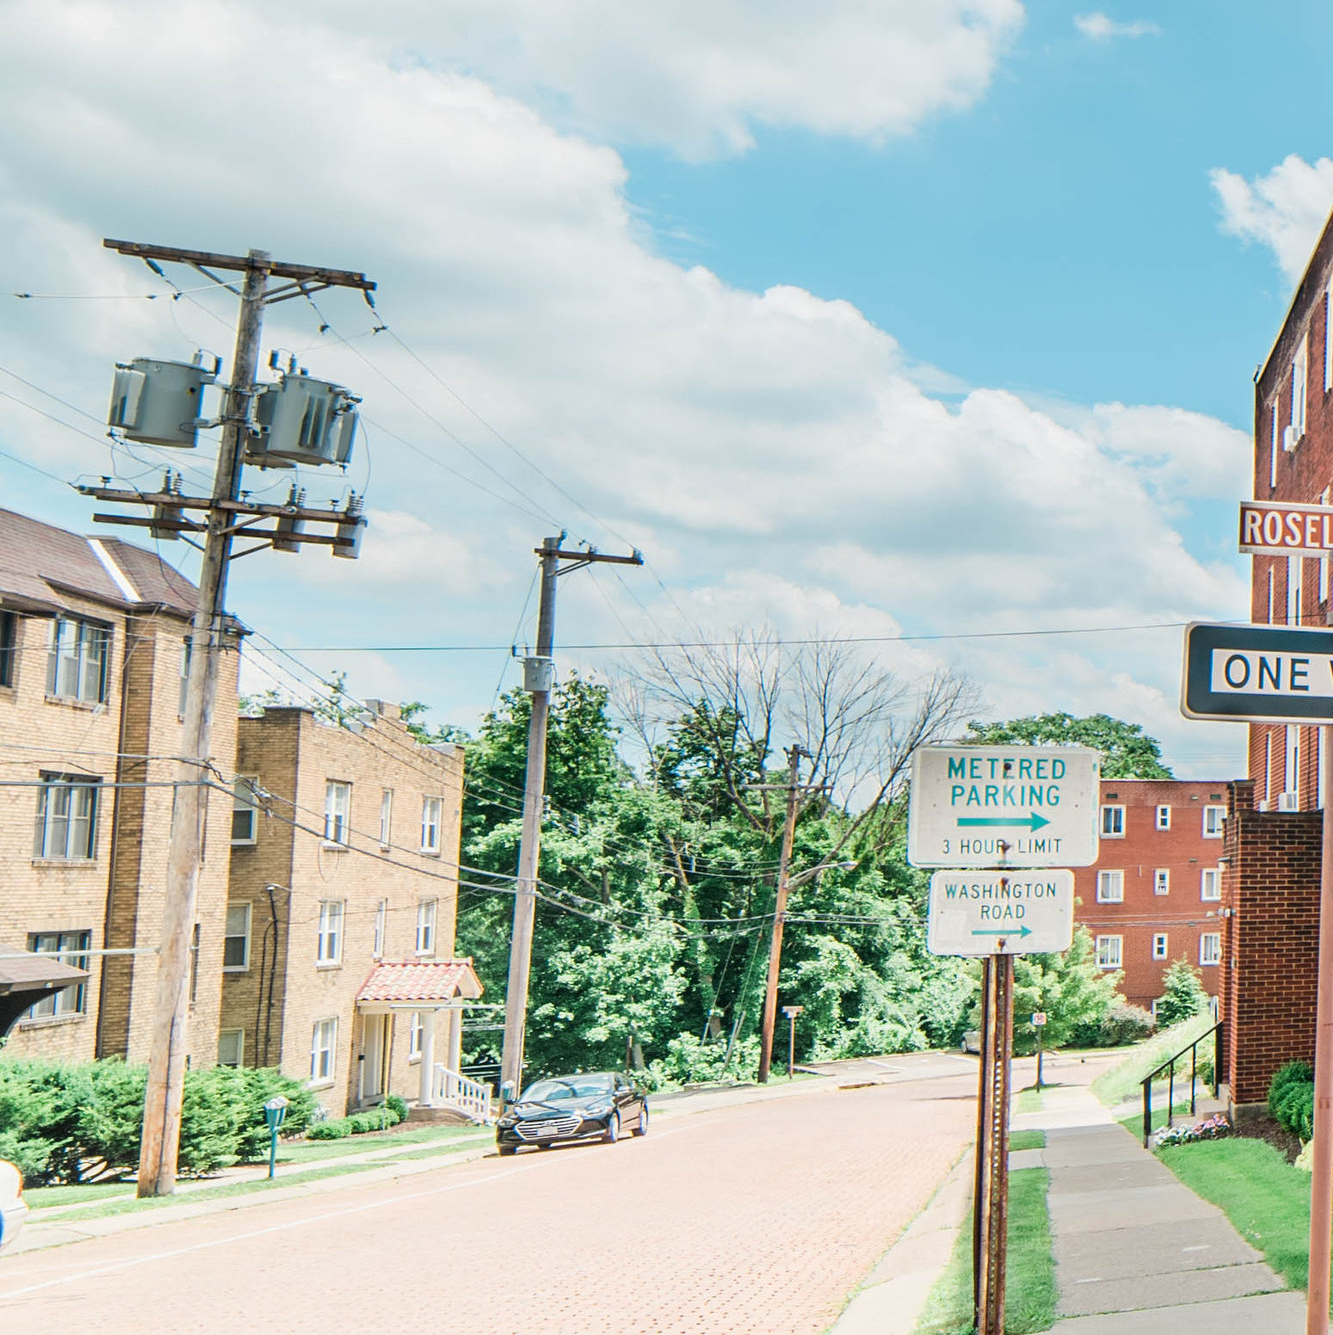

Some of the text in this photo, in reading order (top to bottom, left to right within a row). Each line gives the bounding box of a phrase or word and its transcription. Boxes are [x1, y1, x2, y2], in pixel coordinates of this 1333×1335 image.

[1225, 653, 1310, 692] ONE
[947, 757, 1066, 780] METERED
[951, 785, 1060, 806] PARKING
[942, 839, 1062, 854] 3 HOUR LIMIT
[945, 883, 1056, 899] WASHINGTON
[980, 905, 1025, 920] ROAD
